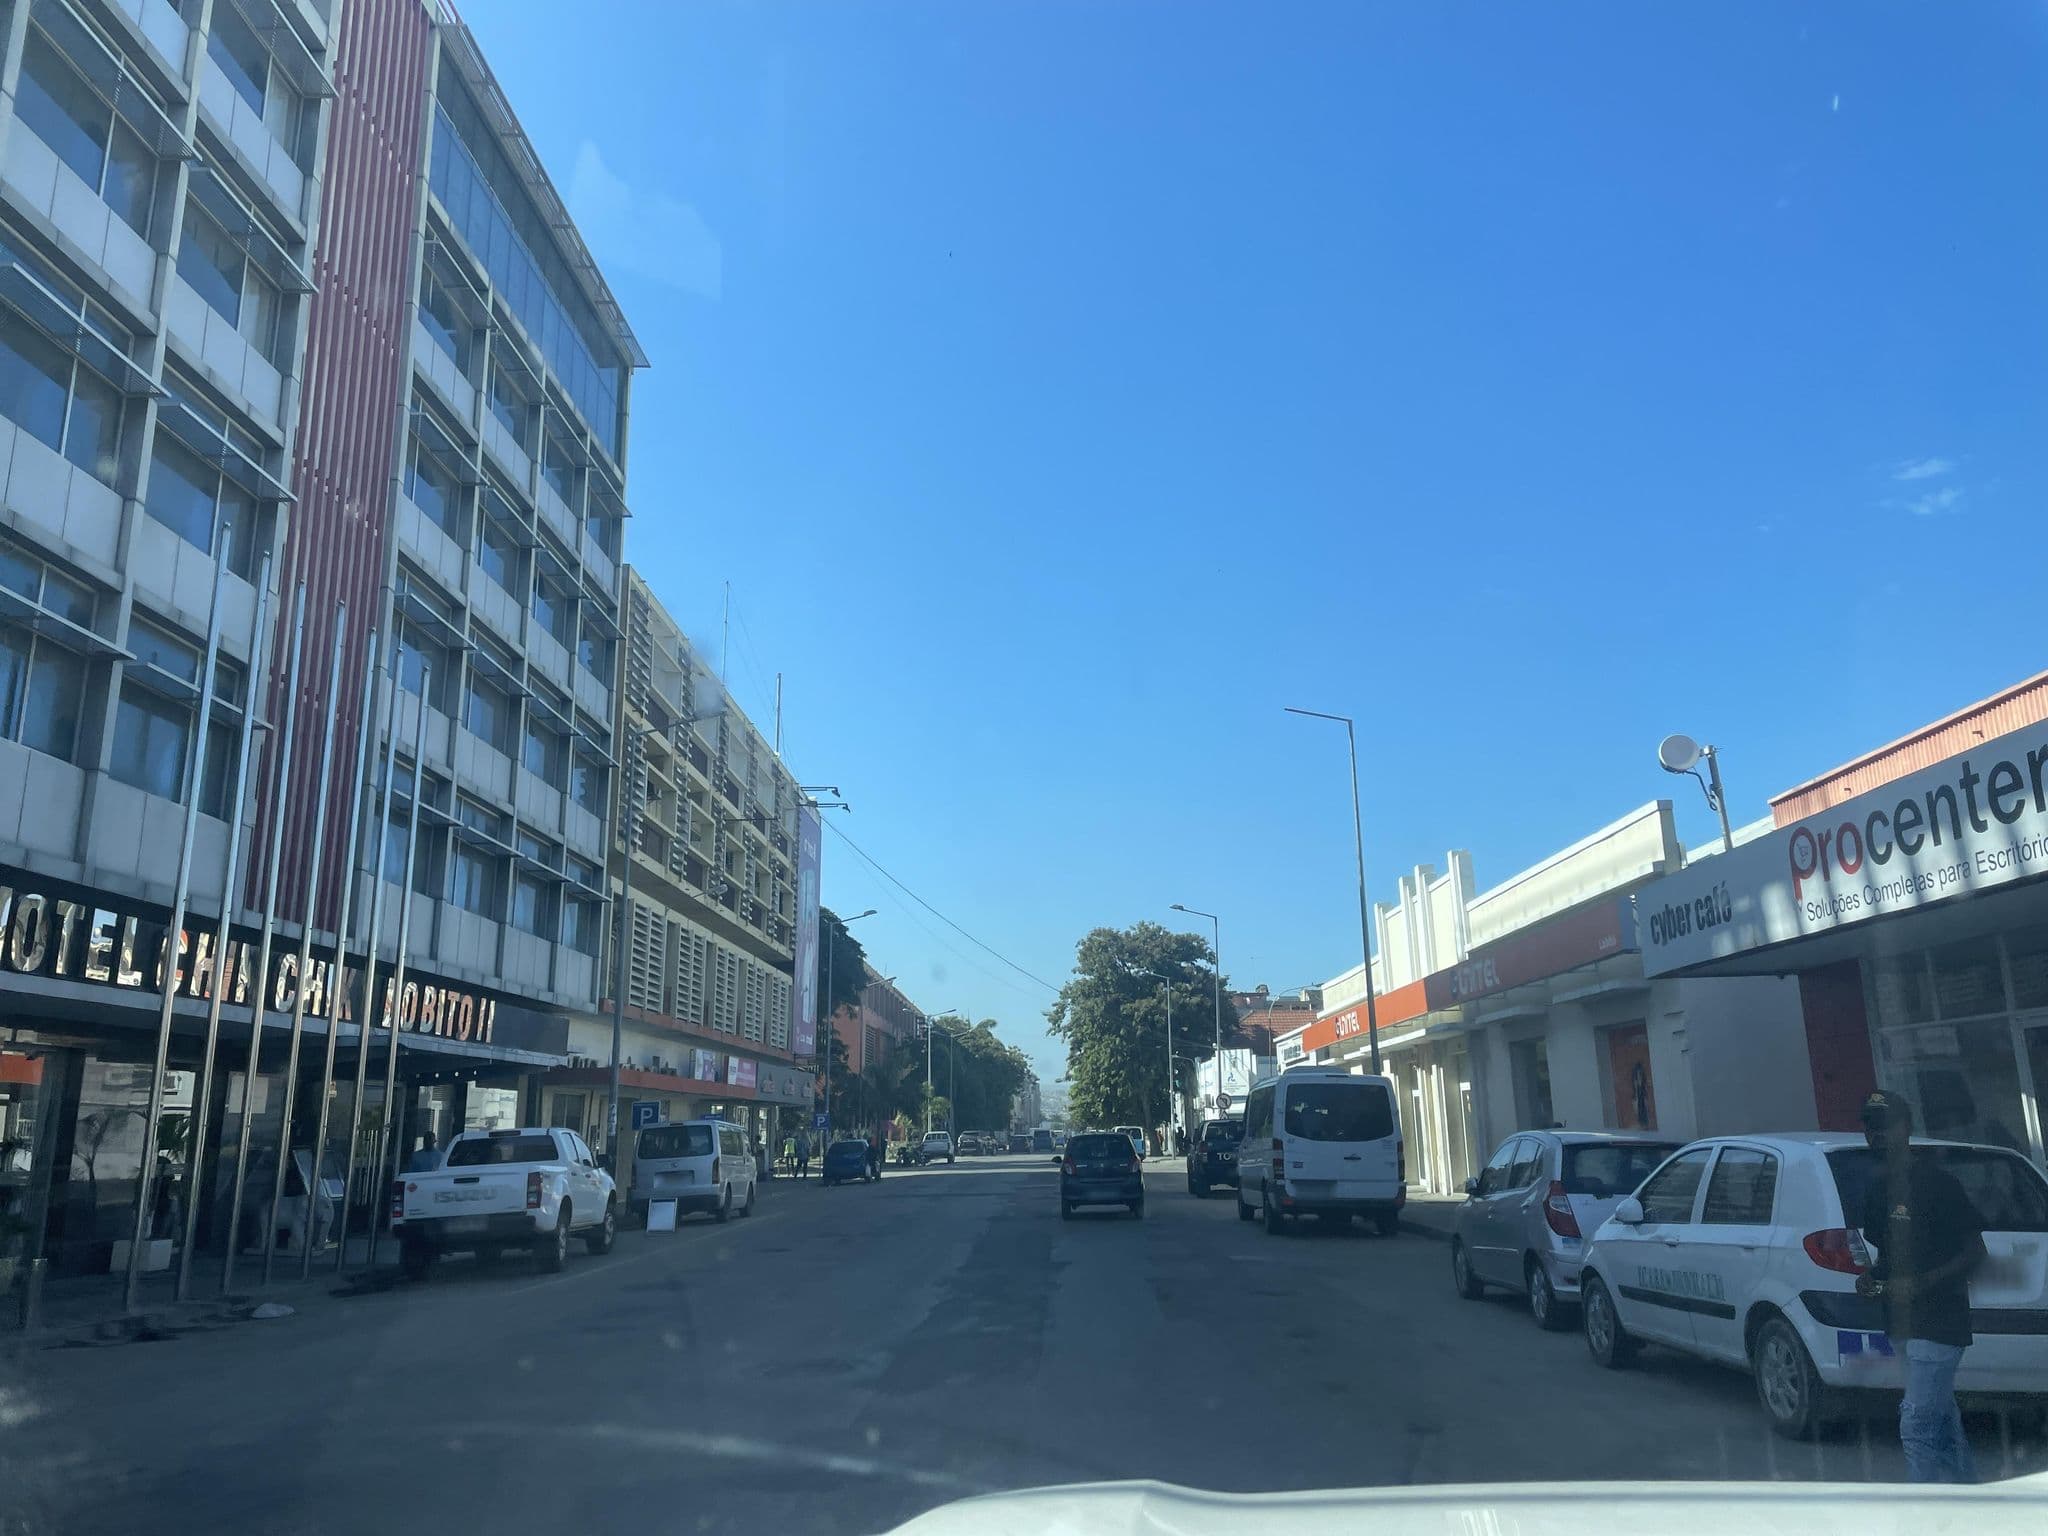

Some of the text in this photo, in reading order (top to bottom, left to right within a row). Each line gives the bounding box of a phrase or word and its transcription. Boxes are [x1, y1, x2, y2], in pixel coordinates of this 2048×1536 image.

[1789, 744, 2048, 901] procenter
[1650, 880, 1732, 947] cyber café
[1807, 892, 1861, 921] Soluções
[1863, 871, 1935, 906] Completas
[1938, 860, 1971, 890] para
[641, 1108, 653, 1125] P
[817, 1117, 825, 1126] P
